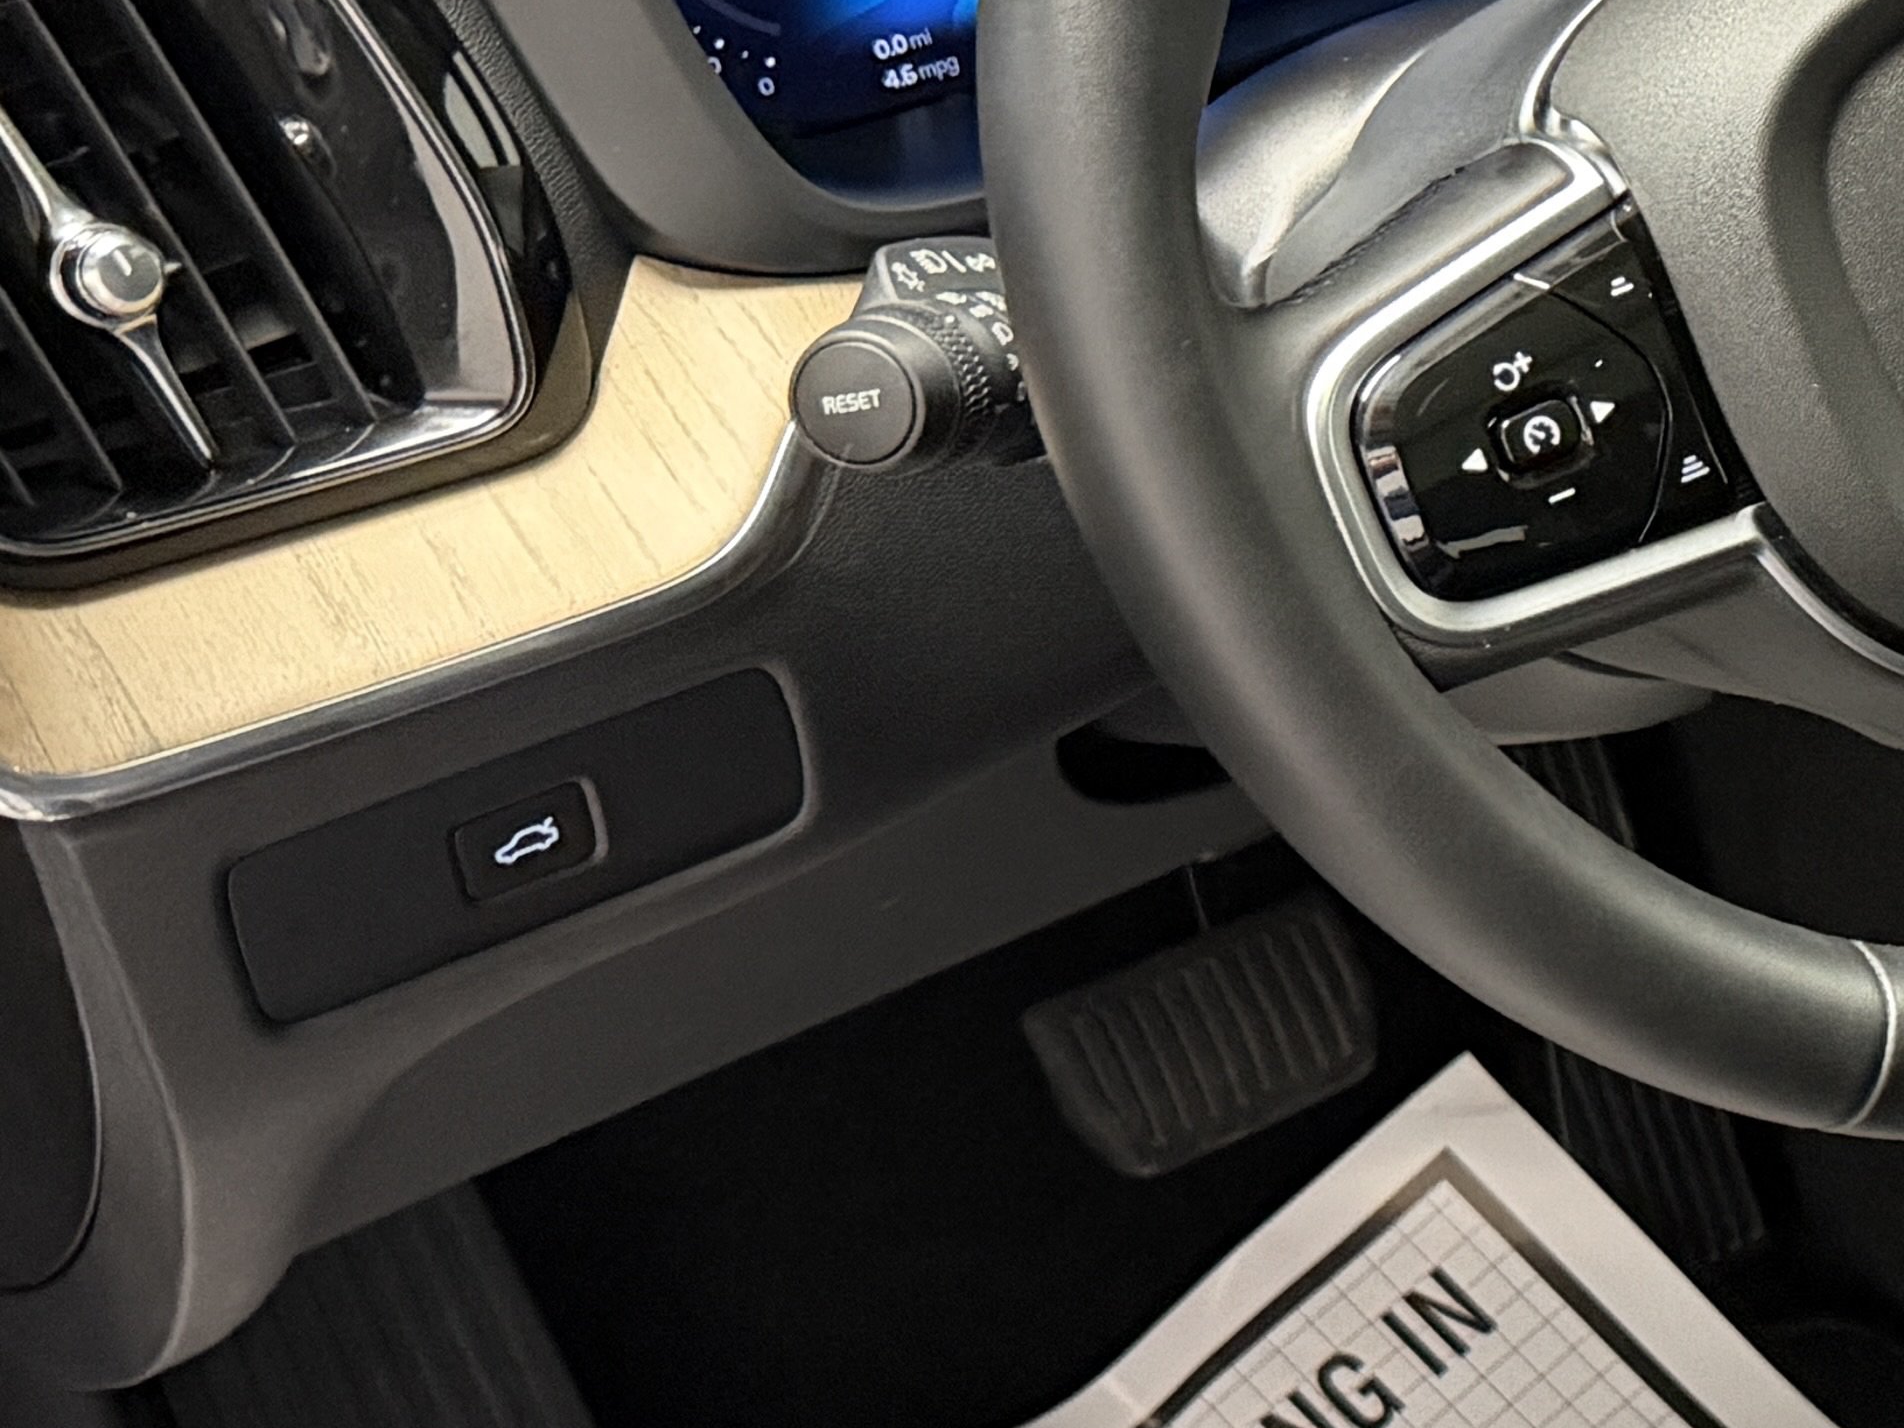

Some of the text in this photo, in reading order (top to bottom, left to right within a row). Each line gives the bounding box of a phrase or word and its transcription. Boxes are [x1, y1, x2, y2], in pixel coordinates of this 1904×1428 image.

[872, 28, 934, 61] 0.0 mi
[757, 76, 776, 97] 0
[881, 55, 961, 90] 4.6 mpg
[820, 387, 882, 416] RESET
[1381, 1263, 1497, 1377] IN
